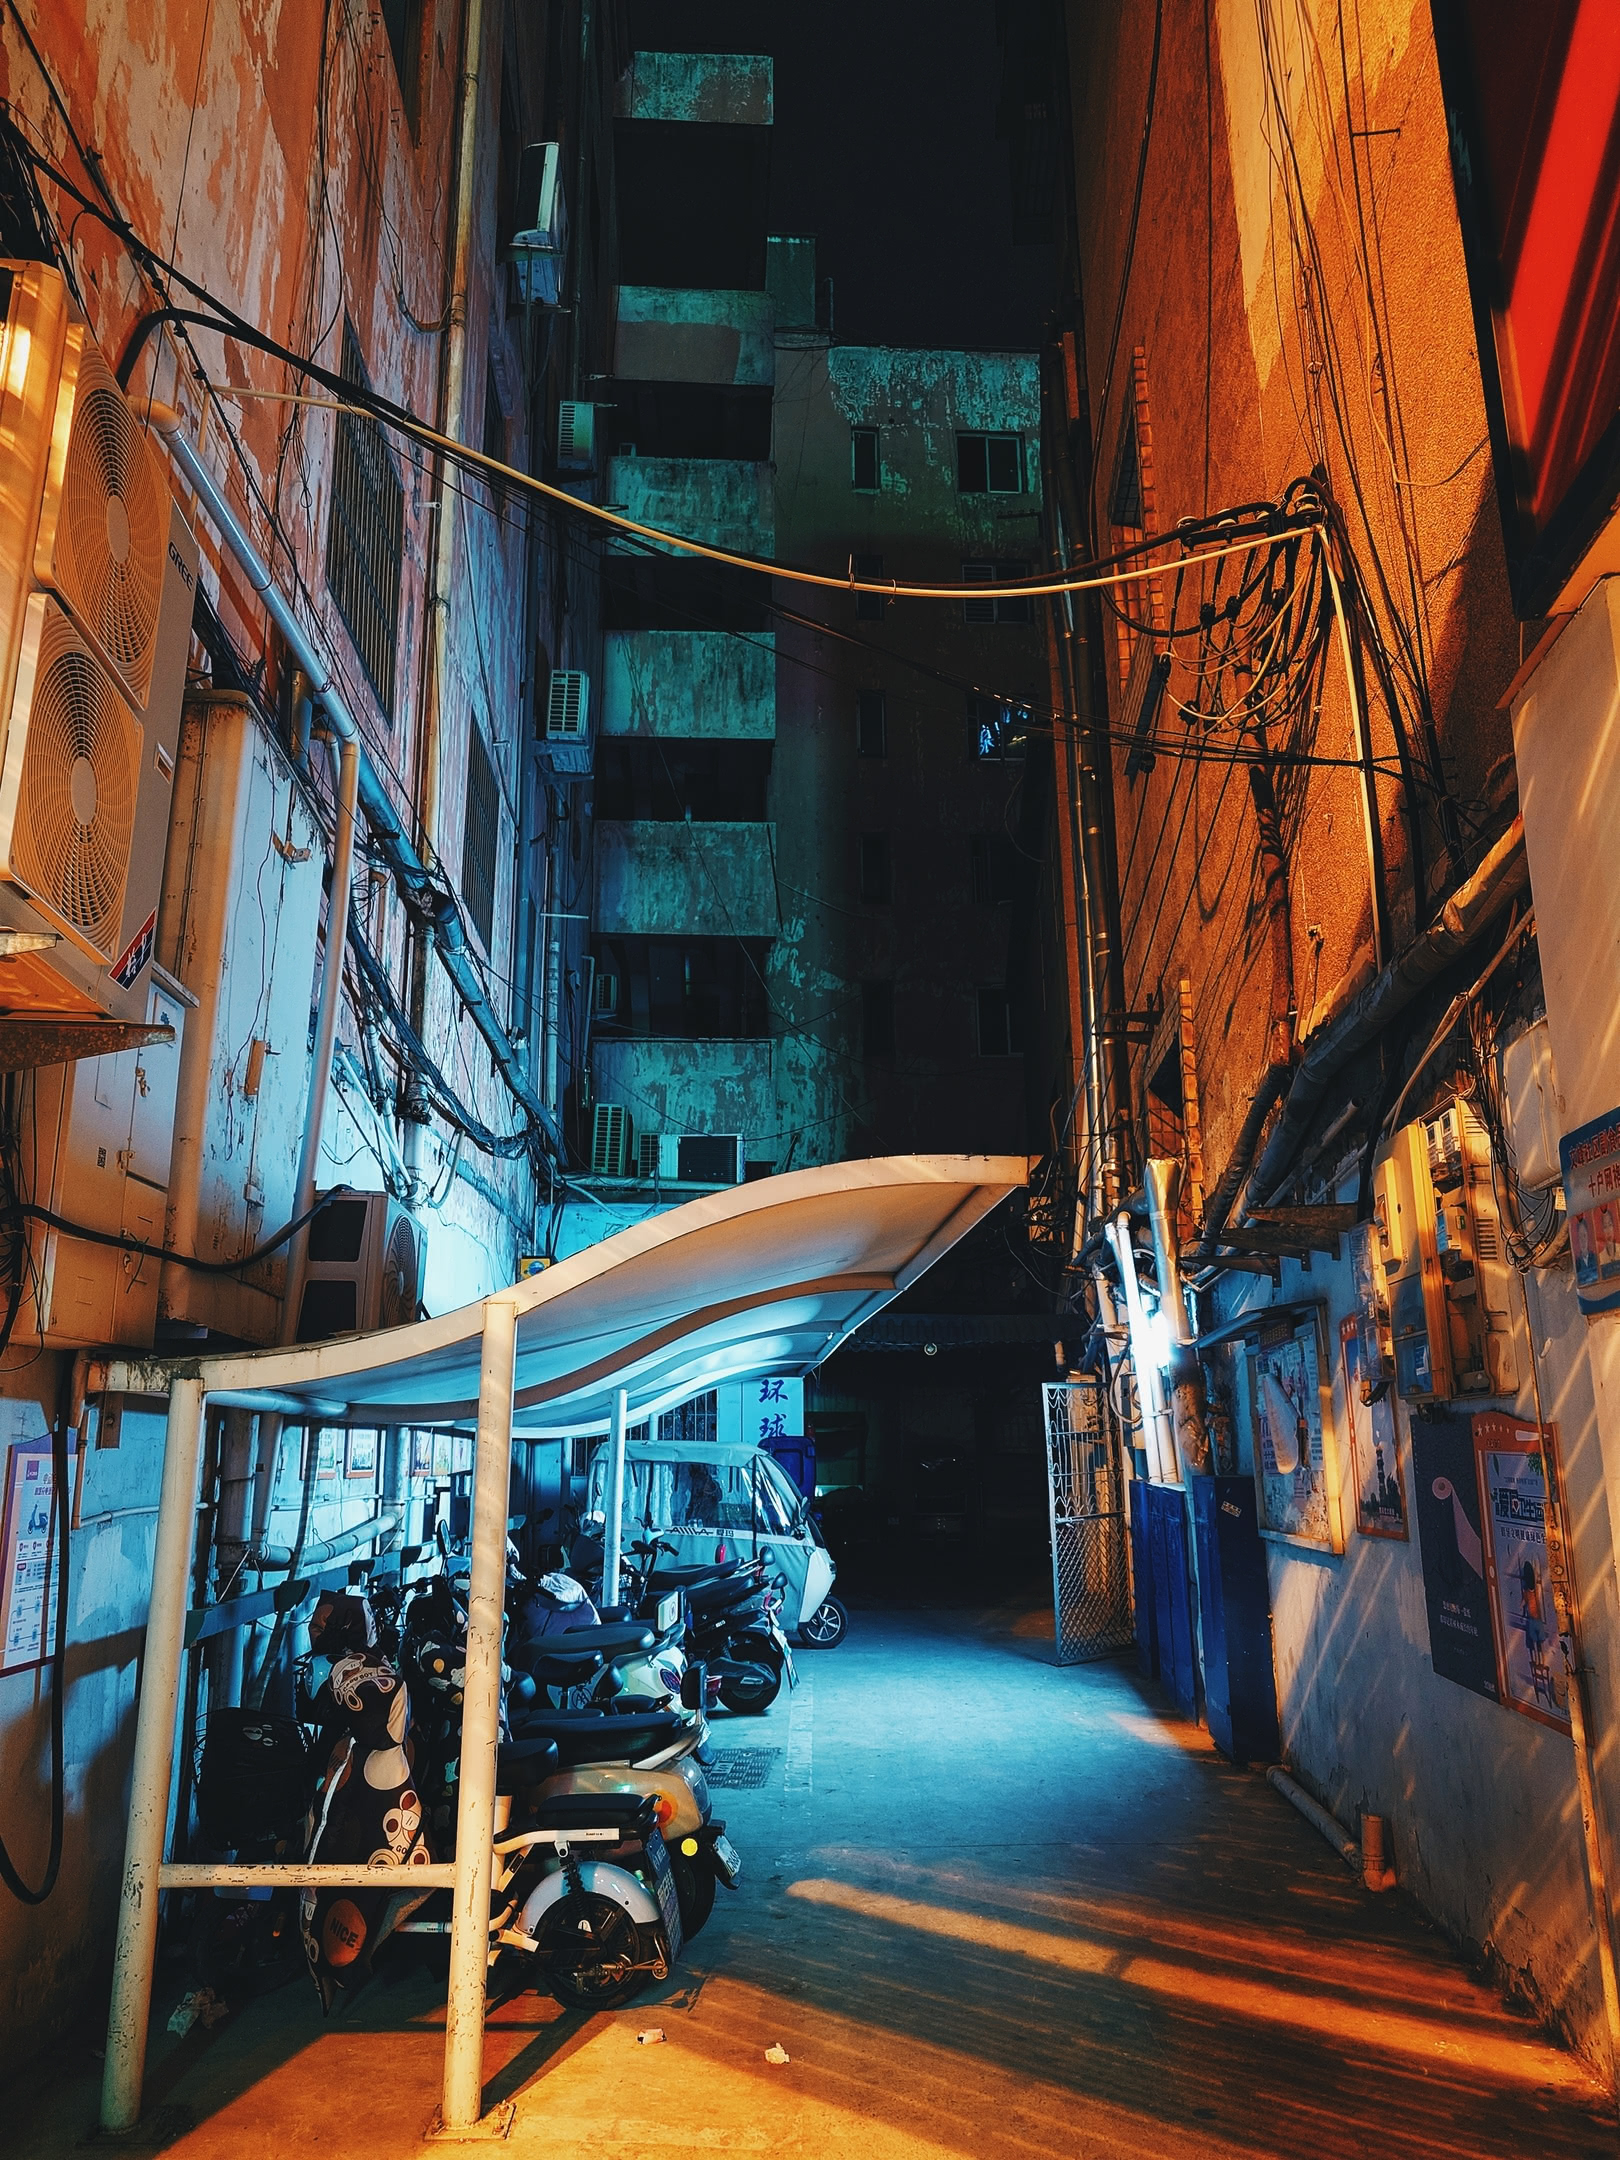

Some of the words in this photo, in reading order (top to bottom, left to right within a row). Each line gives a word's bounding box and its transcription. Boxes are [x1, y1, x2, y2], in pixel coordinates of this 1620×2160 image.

[168, 541, 193, 592] GREE
[759, 1379, 788, 1437] 环球
[329, 1916, 359, 1948] NICE
